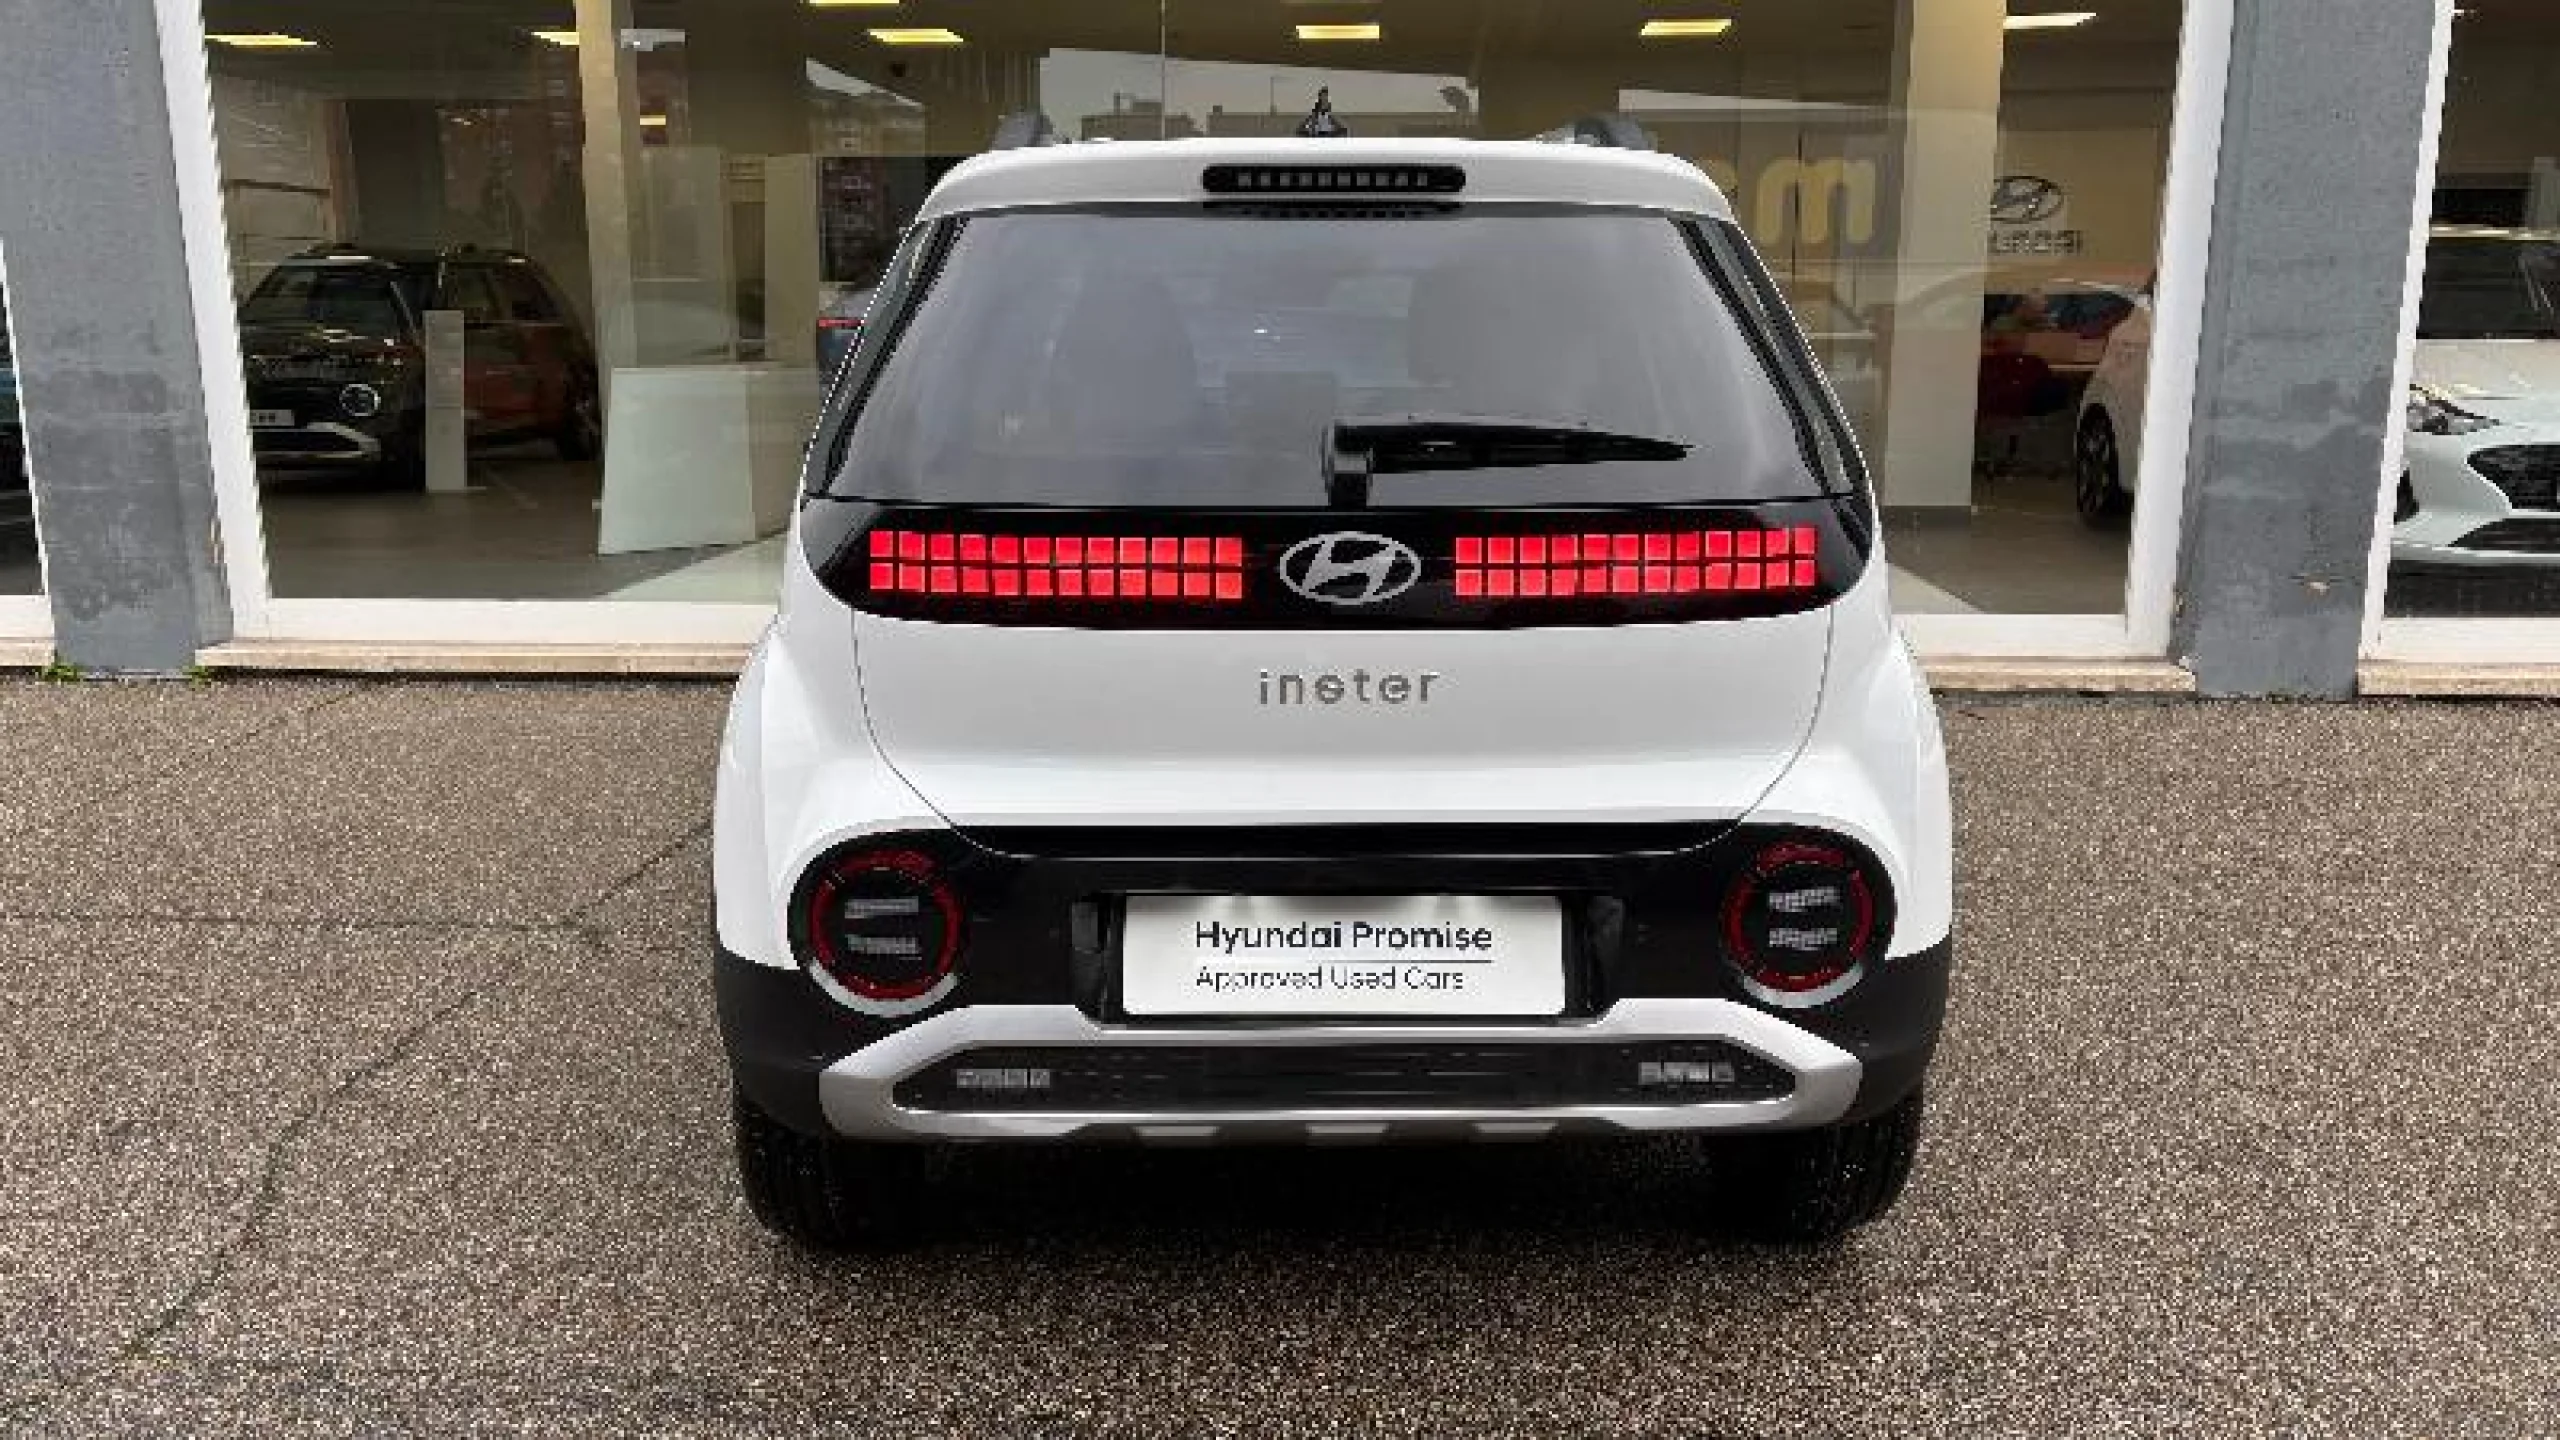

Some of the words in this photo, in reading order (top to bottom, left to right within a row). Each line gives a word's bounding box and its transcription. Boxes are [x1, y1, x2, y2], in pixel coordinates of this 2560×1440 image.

[1196, 921, 1342, 954] Hyundai
[1352, 921, 1492, 951] Promise
[1196, 965, 1323, 992] Approved
[1330, 965, 1396, 990] Used
[1403, 965, 1465, 990] Cars
